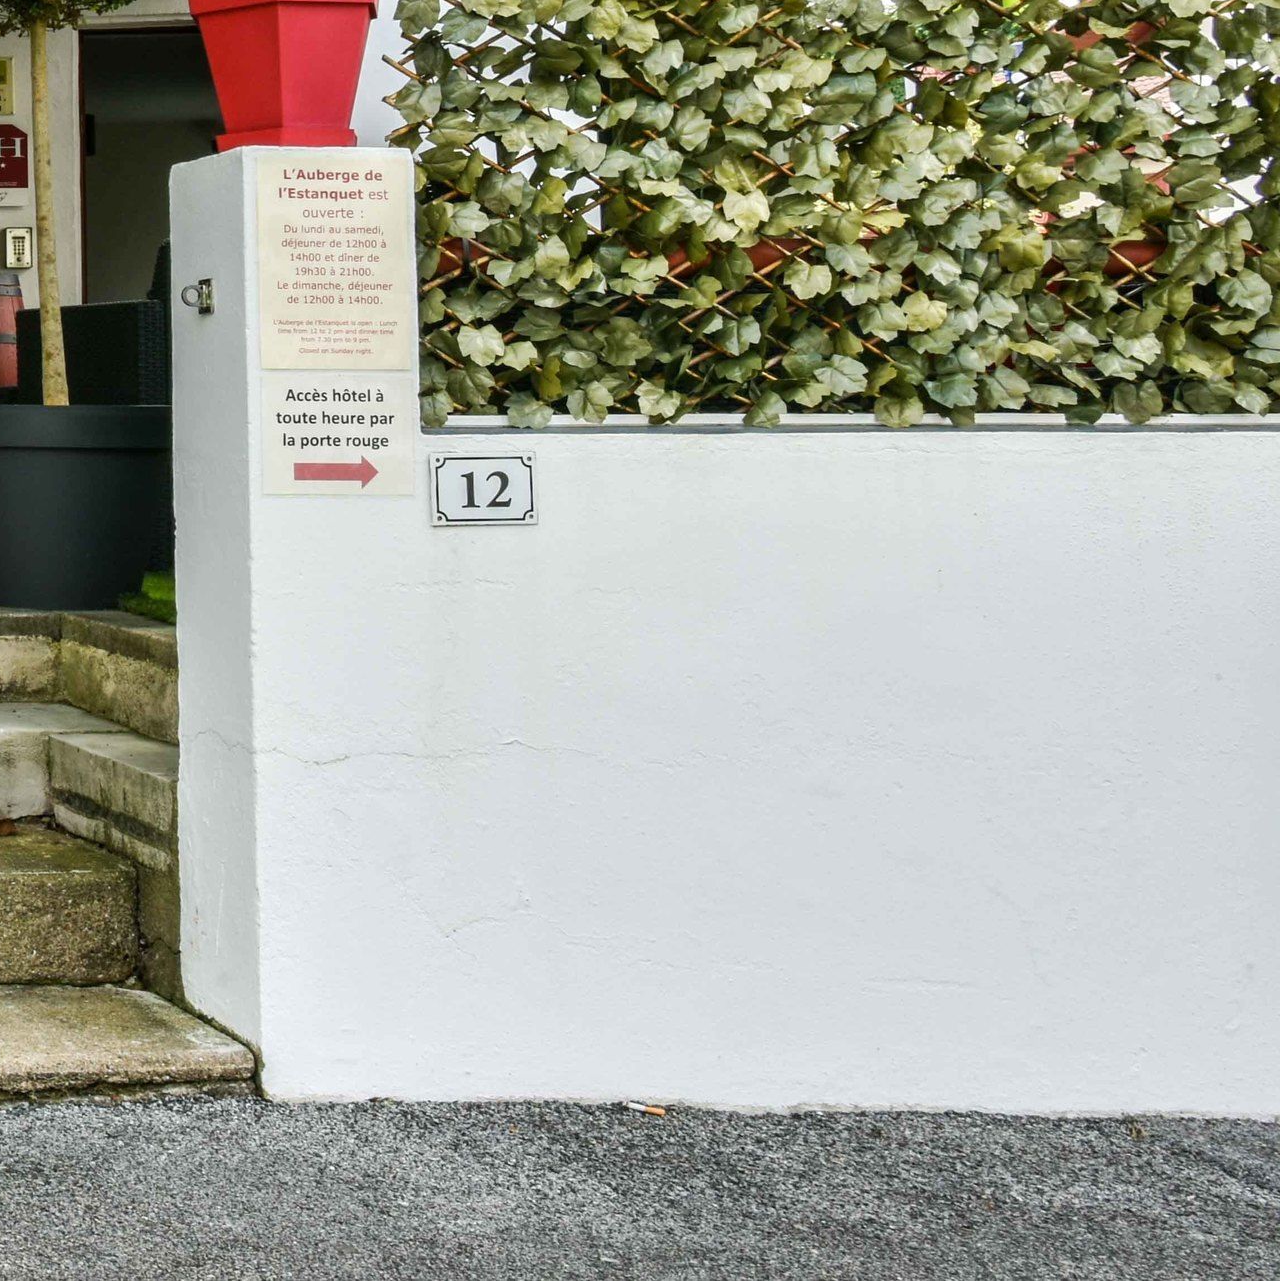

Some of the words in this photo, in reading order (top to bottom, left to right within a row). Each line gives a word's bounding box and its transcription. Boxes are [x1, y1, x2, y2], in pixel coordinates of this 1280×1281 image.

[283, 168, 359, 183] L'Auberge
[364, 170, 382, 181] de
[278, 187, 363, 201] l'Estanquet
[368, 190, 388, 200] est
[302, 208, 354, 219] ouverte
[284, 223, 298, 234] Du
[301, 225, 325, 234] lundi
[344, 225, 384, 236] samedi,
[281, 238, 326, 250] déjeuner
[329, 239, 342, 248] de
[346, 239, 377, 249] 12h00
[380, 239, 387, 249] à
[290, 252, 321, 262] 14h00
[324, 254, 335, 262] et
[338, 253, 365, 262] dîner
[367, 253, 381, 263] de
[295, 267, 326, 276] 19h30
[330, 266, 336, 276] à
[339, 267, 375, 277] 21h00.
[277, 281, 289, 290] Le
[292, 281, 344, 292] dimanche,
[348, 281, 393, 292] déjeuner
[287, 295, 299, 304] de
[304, 295, 335, 304] 12h00
[337, 295, 344, 304] à
[349, 295, 383, 305] 14h00.
[285, 388, 328, 402] Accès
[332, 388, 371, 402] hôtel
[376, 389, 384, 402] à
[276, 412, 317, 424] toute
[322, 411, 365, 425] heure
[370, 415, 395, 427] par
[283, 433, 295, 446] la
[300, 435, 341, 449] porte
[346, 437, 389, 450] rouge
[460, 470, 513, 510] 12
